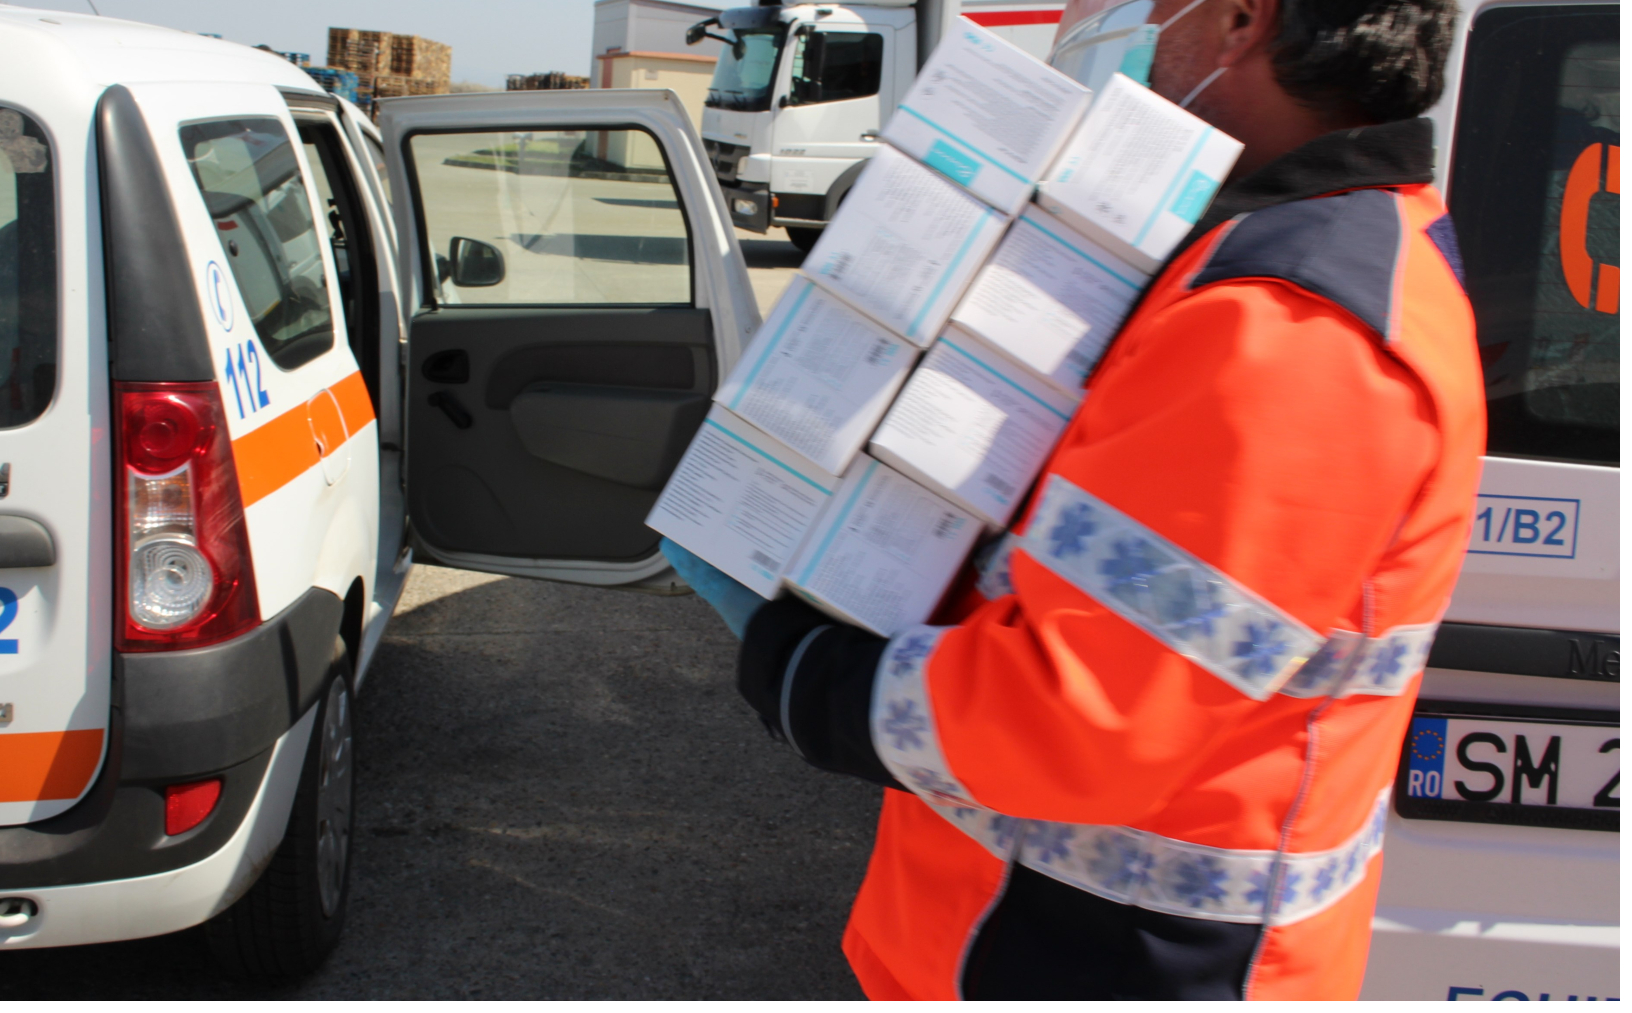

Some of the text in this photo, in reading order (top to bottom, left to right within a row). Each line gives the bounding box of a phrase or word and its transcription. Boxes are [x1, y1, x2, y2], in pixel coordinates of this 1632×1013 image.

[225, 339, 271, 420] 112
[1408, 769, 1441, 798] RO
[1454, 732, 1562, 806] SM
